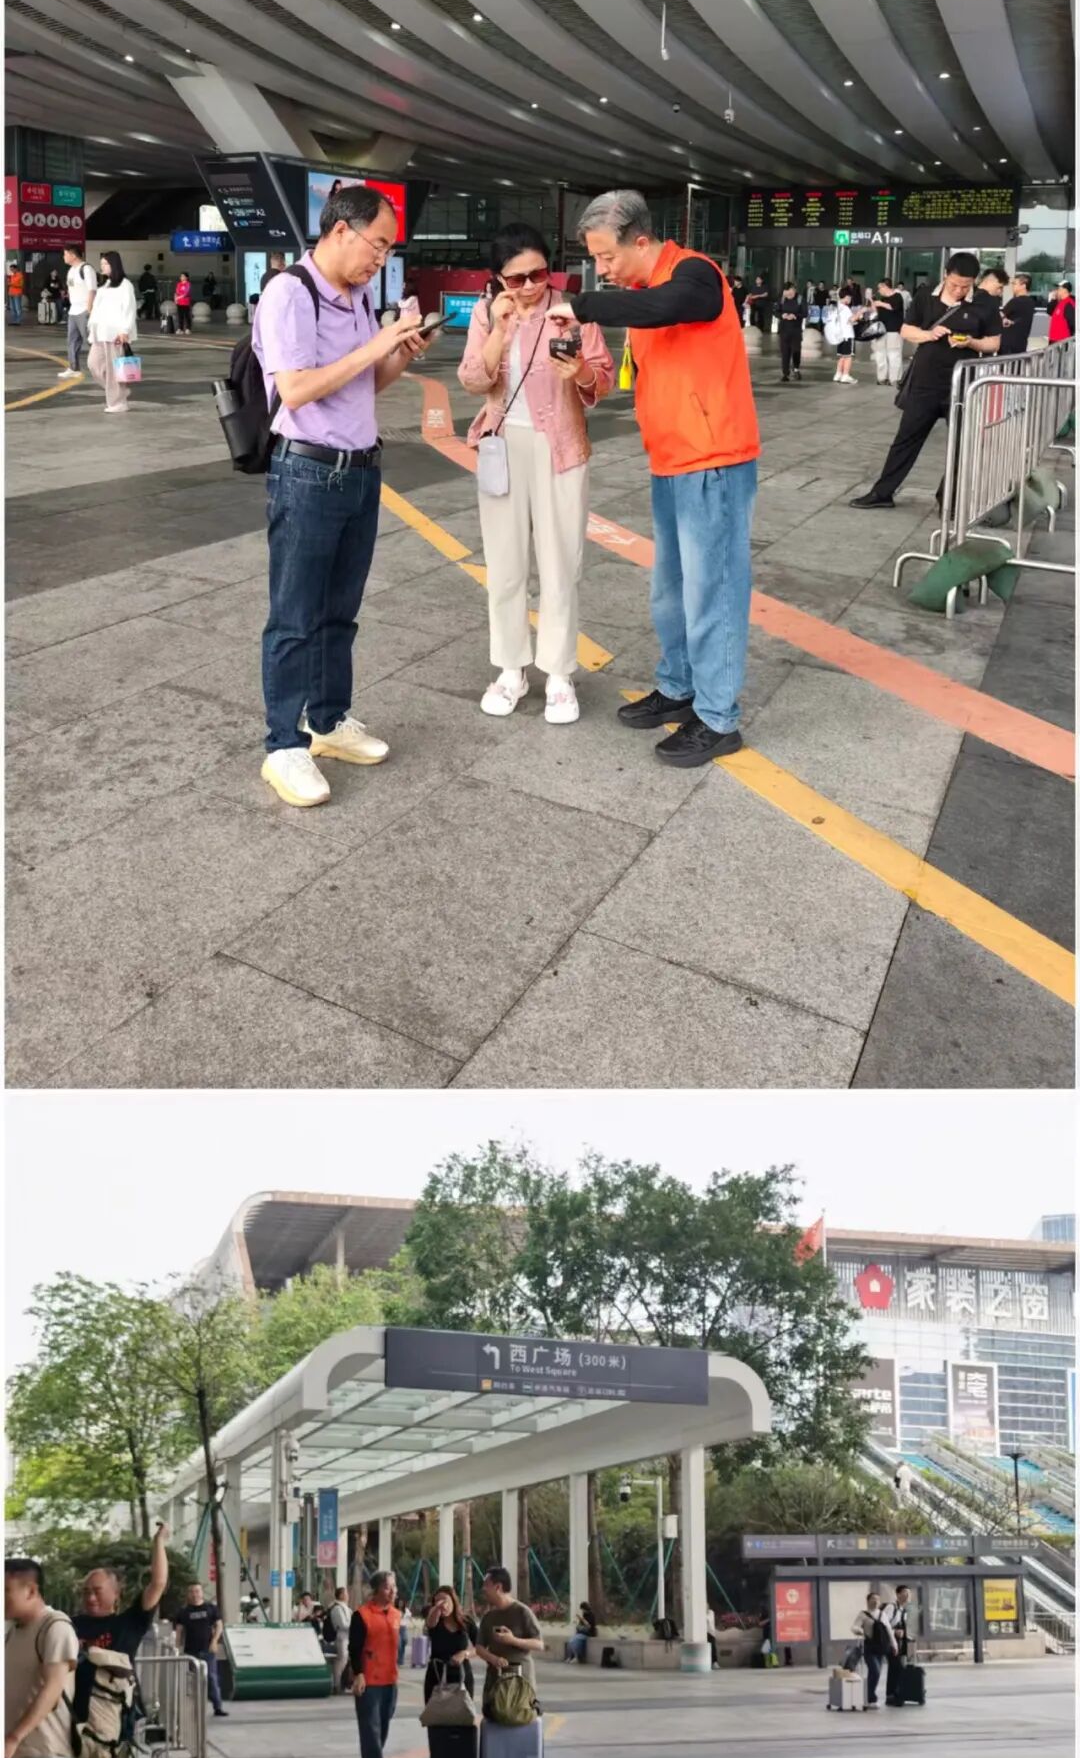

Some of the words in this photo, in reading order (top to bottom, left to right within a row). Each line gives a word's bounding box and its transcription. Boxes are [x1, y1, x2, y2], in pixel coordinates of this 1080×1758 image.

[870, 231, 890, 245] A1
[905, 1269, 1048, 1321] 家装之窗
[510, 1343, 571, 1368] 西广场
[578, 1354, 627, 1371] (300米)
[510, 1364, 520, 1373] To
[522, 1364, 545, 1375] West
[546, 1367, 577, 1378] Square
